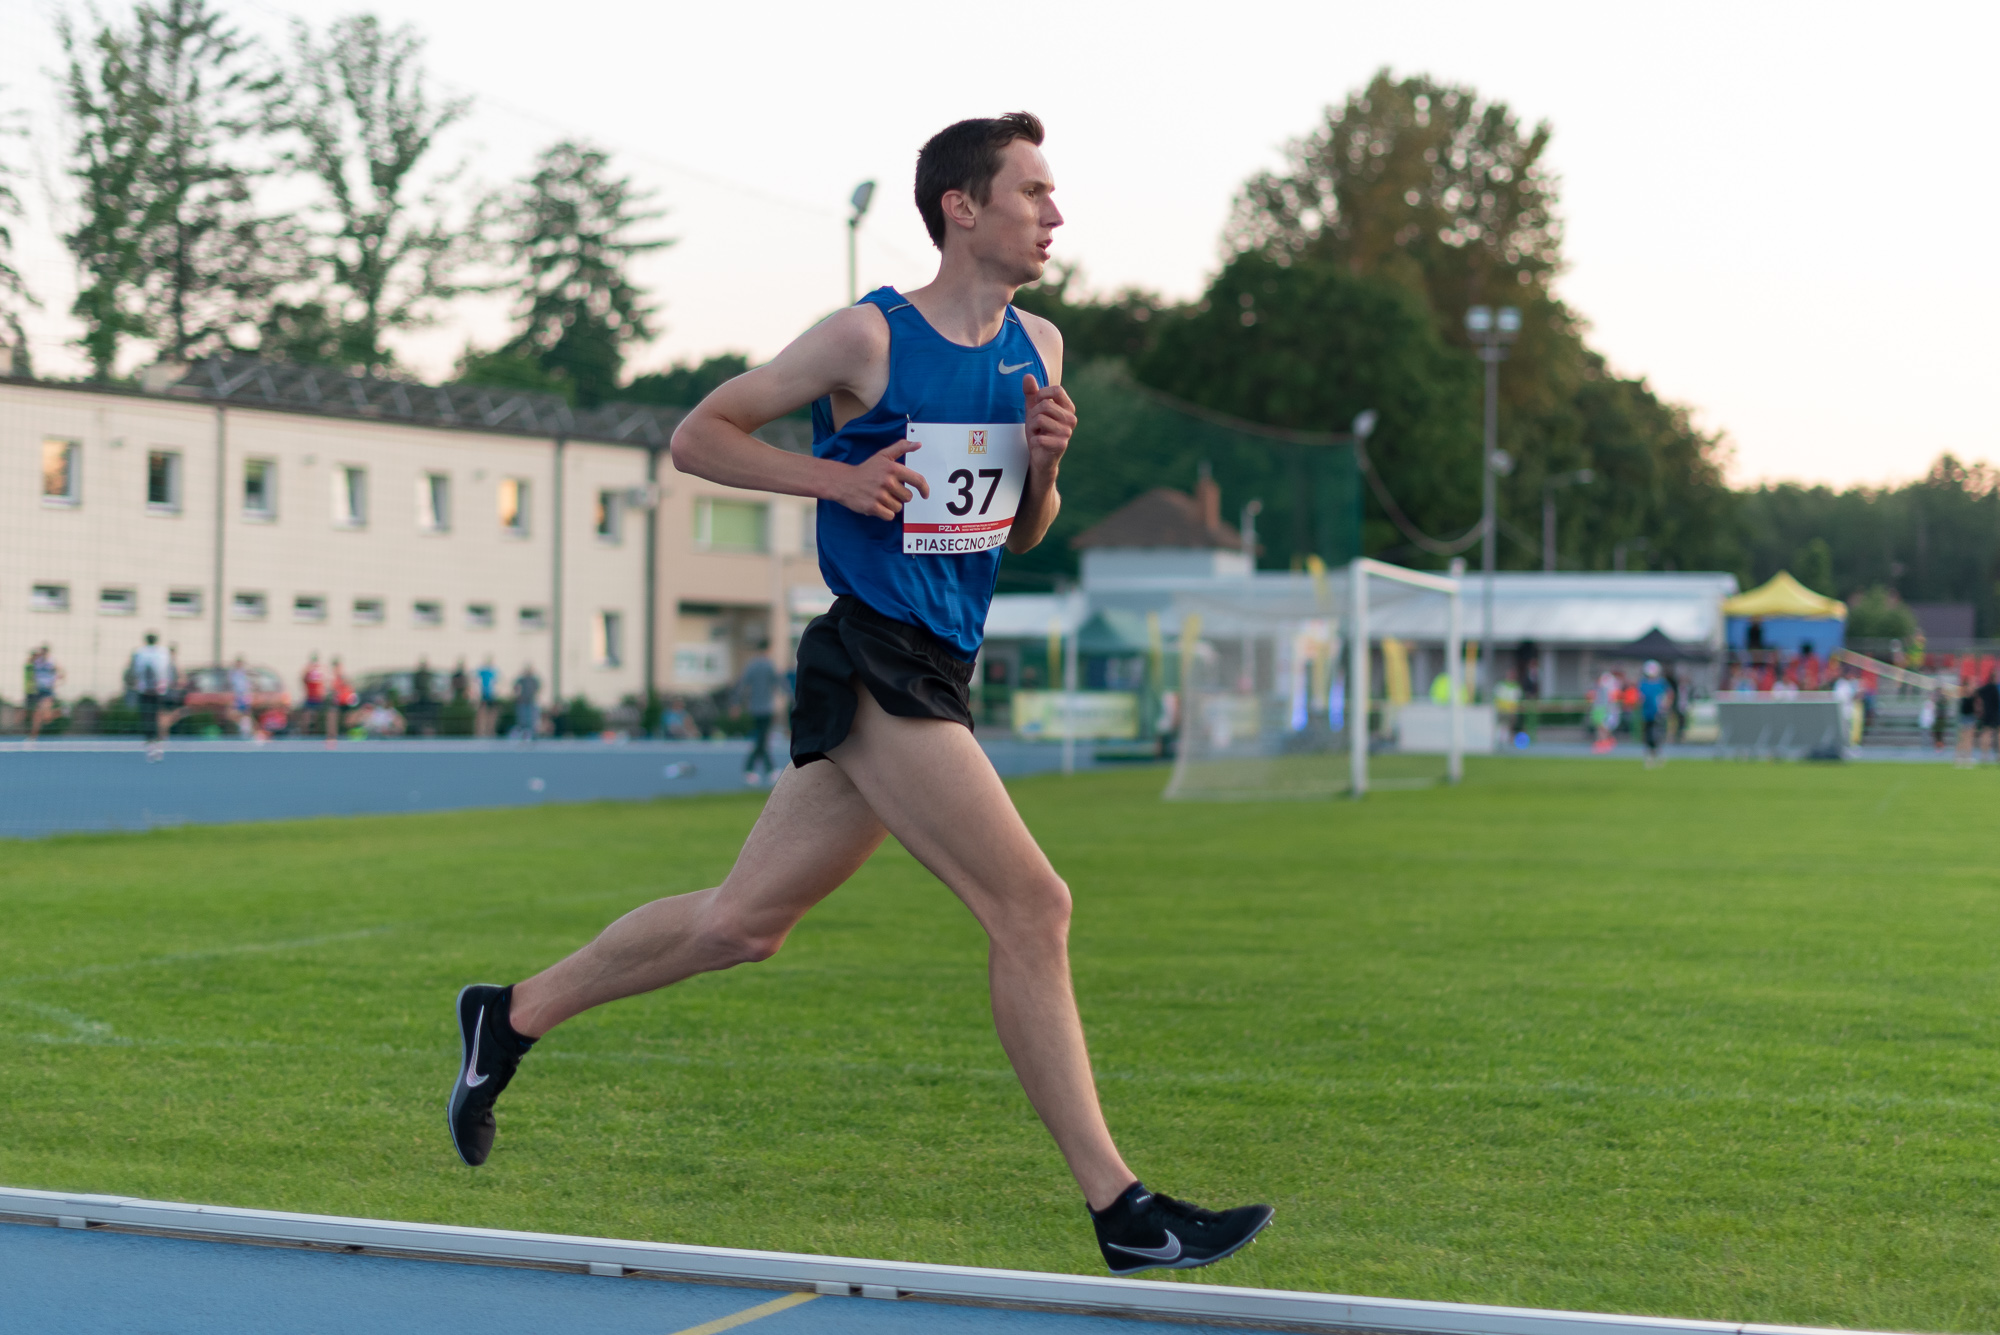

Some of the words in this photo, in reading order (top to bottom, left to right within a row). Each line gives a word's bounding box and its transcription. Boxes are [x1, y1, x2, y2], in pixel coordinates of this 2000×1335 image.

[945, 468, 1003, 516] 37
[915, 537, 986, 552] PIASECZNO
[986, 533, 1004, 548] 2021
